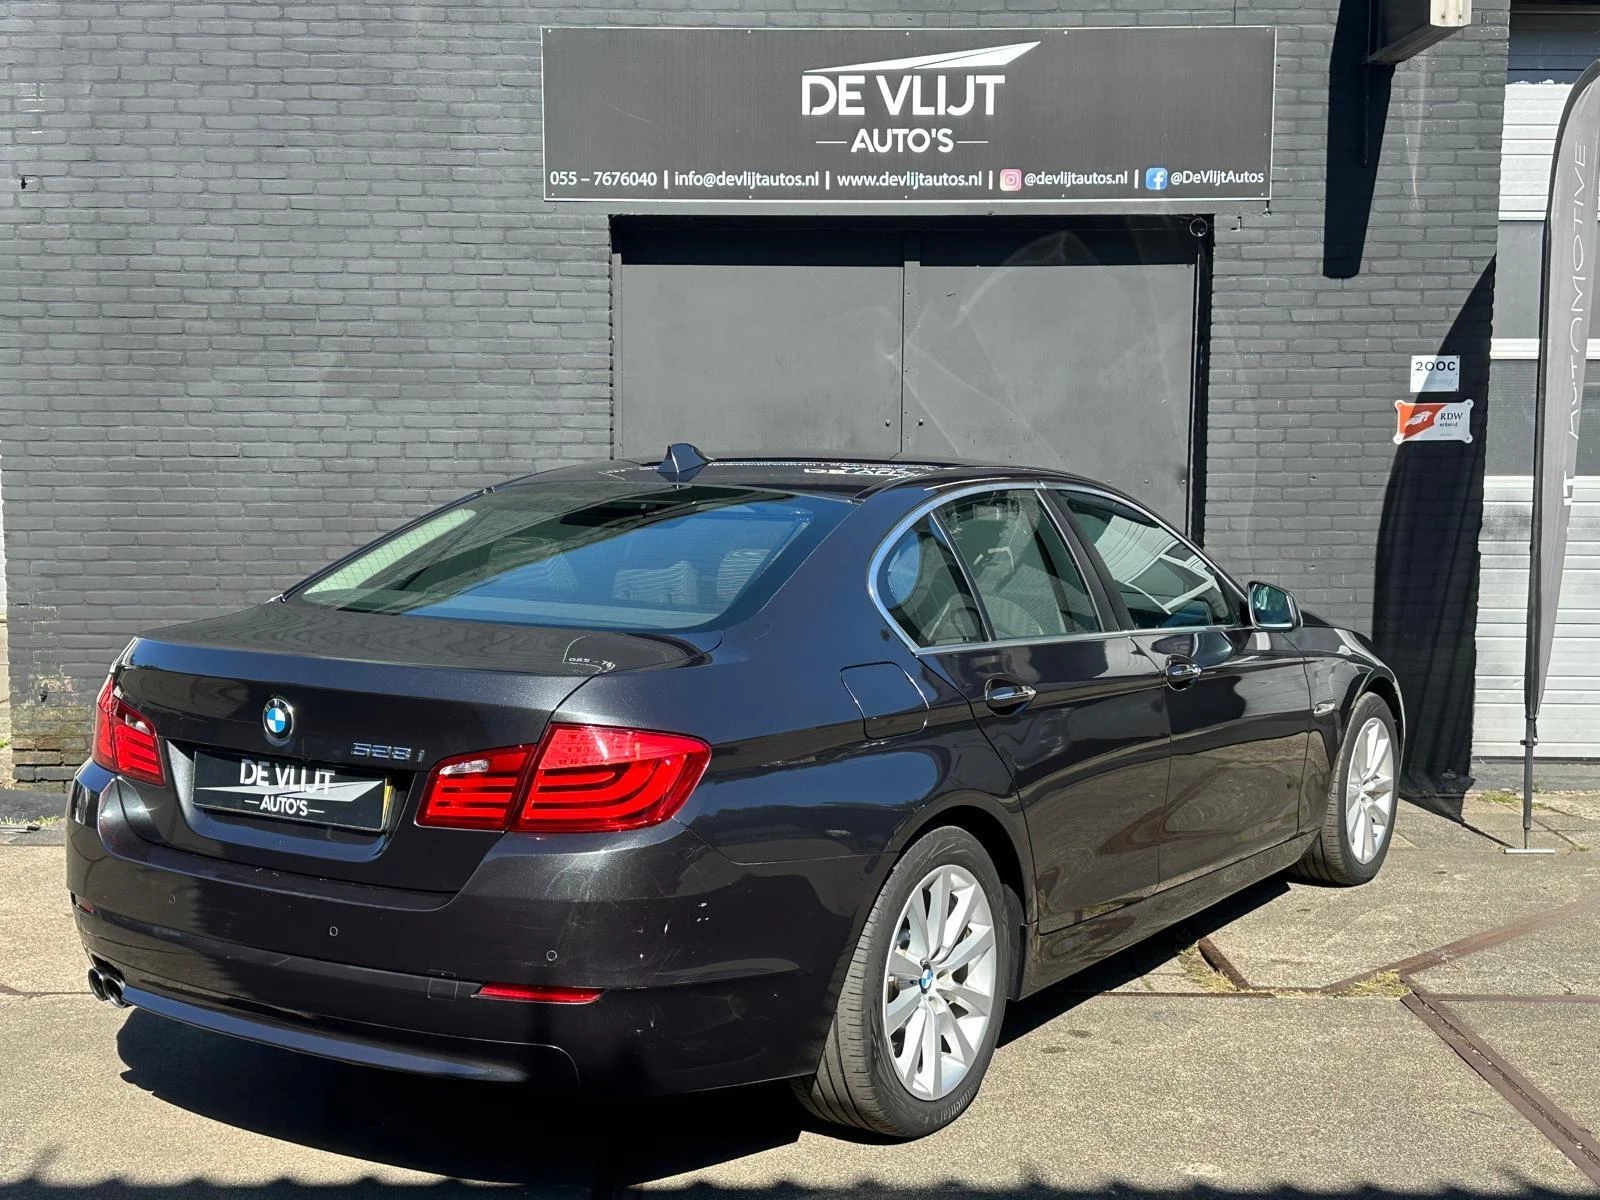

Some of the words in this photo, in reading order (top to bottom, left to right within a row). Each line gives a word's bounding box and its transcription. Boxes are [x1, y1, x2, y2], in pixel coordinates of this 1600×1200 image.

[802, 75, 865, 116] DE
[876, 75, 1005, 116] VLIJT
[850, 128, 954, 153] AUTO'S
[550, 171, 577, 186] 055
[593, 171, 657, 187] 7676040
[674, 171, 819, 190] info@devlijtautos.nl
[837, 171, 982, 190] www.devlijtautos.nl
[1024, 171, 1128, 190] @devlijtautos.nl
[1170, 170, 1264, 187] @DeVlijtAutos
[1440, 412, 1464, 421] RDW
[240, 759, 270, 787] DE
[275, 763, 335, 795] VLIJT
[260, 795, 308, 816] AUTO'S
